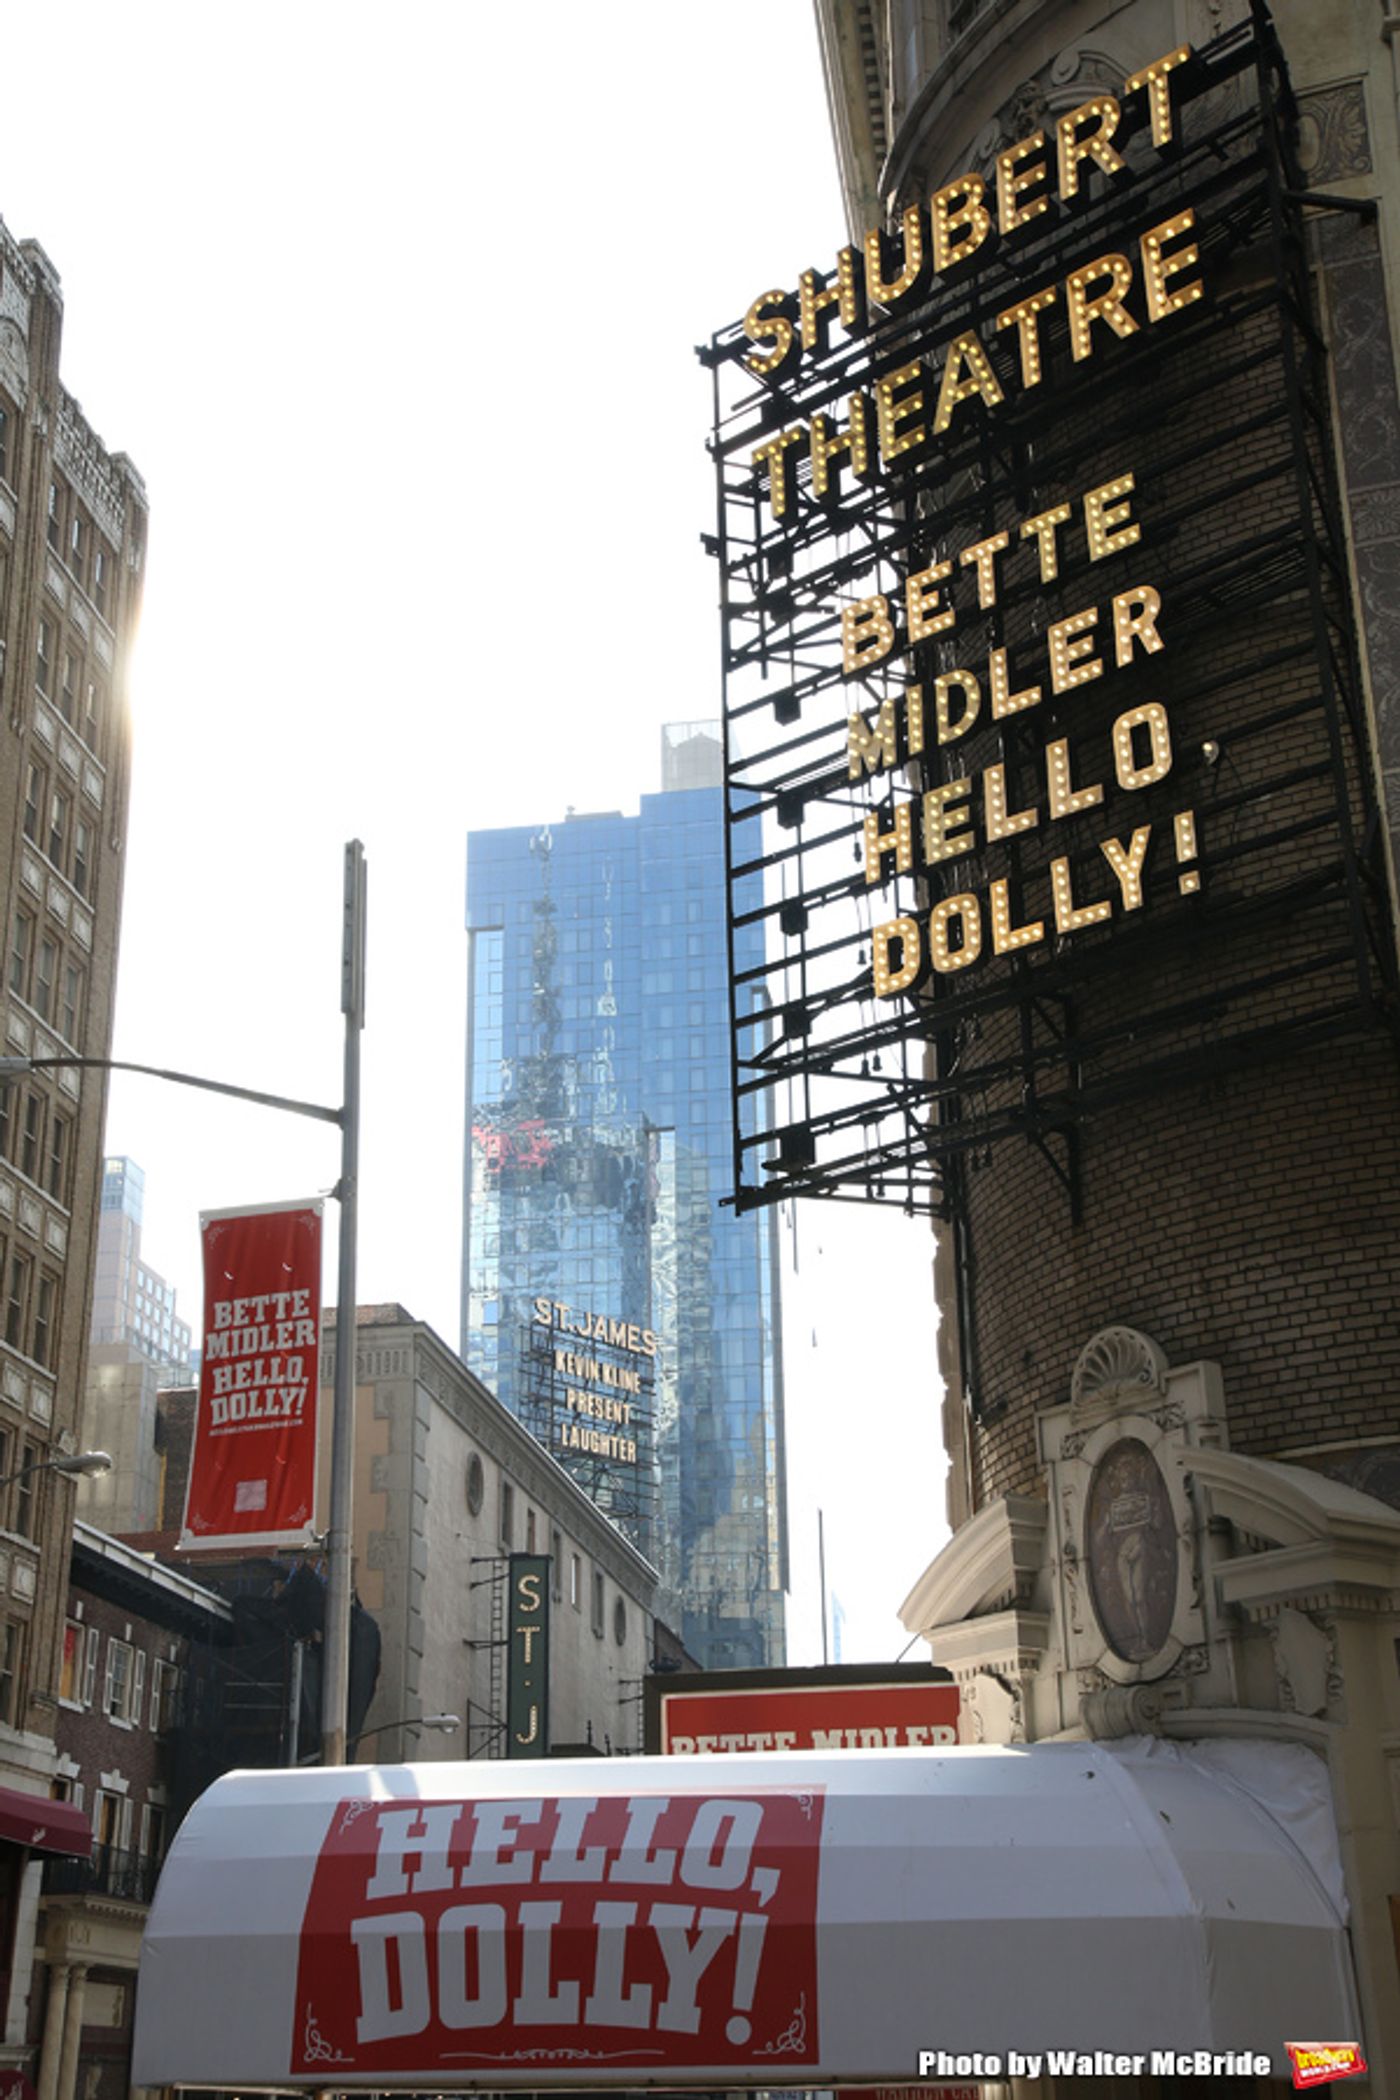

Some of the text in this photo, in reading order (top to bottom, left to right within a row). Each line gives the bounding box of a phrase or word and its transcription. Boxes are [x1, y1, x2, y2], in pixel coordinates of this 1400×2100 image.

[742, 43, 1191, 374] SHUBERT
[752, 208, 1203, 518] THEATRE
[841, 473, 1141, 675] BETTE
[847, 585, 1165, 781] MIDLER
[863, 702, 1172, 884] HELLO
[872, 811, 1200, 998] DOLLY!
[206, 1318, 316, 1360] MIDLER
[214, 1288, 310, 1329] BETTE
[210, 1387, 307, 1426] DOLLY!
[212, 1355, 310, 1395] HELLO,
[554, 1350, 641, 1394] KEVIN KLINE
[566, 1388, 631, 1425] PRESENT
[561, 1423, 637, 1464] LAUGHTER
[366, 1796, 782, 1908] HELLO,
[349, 1900, 770, 2046] DOLLY!
